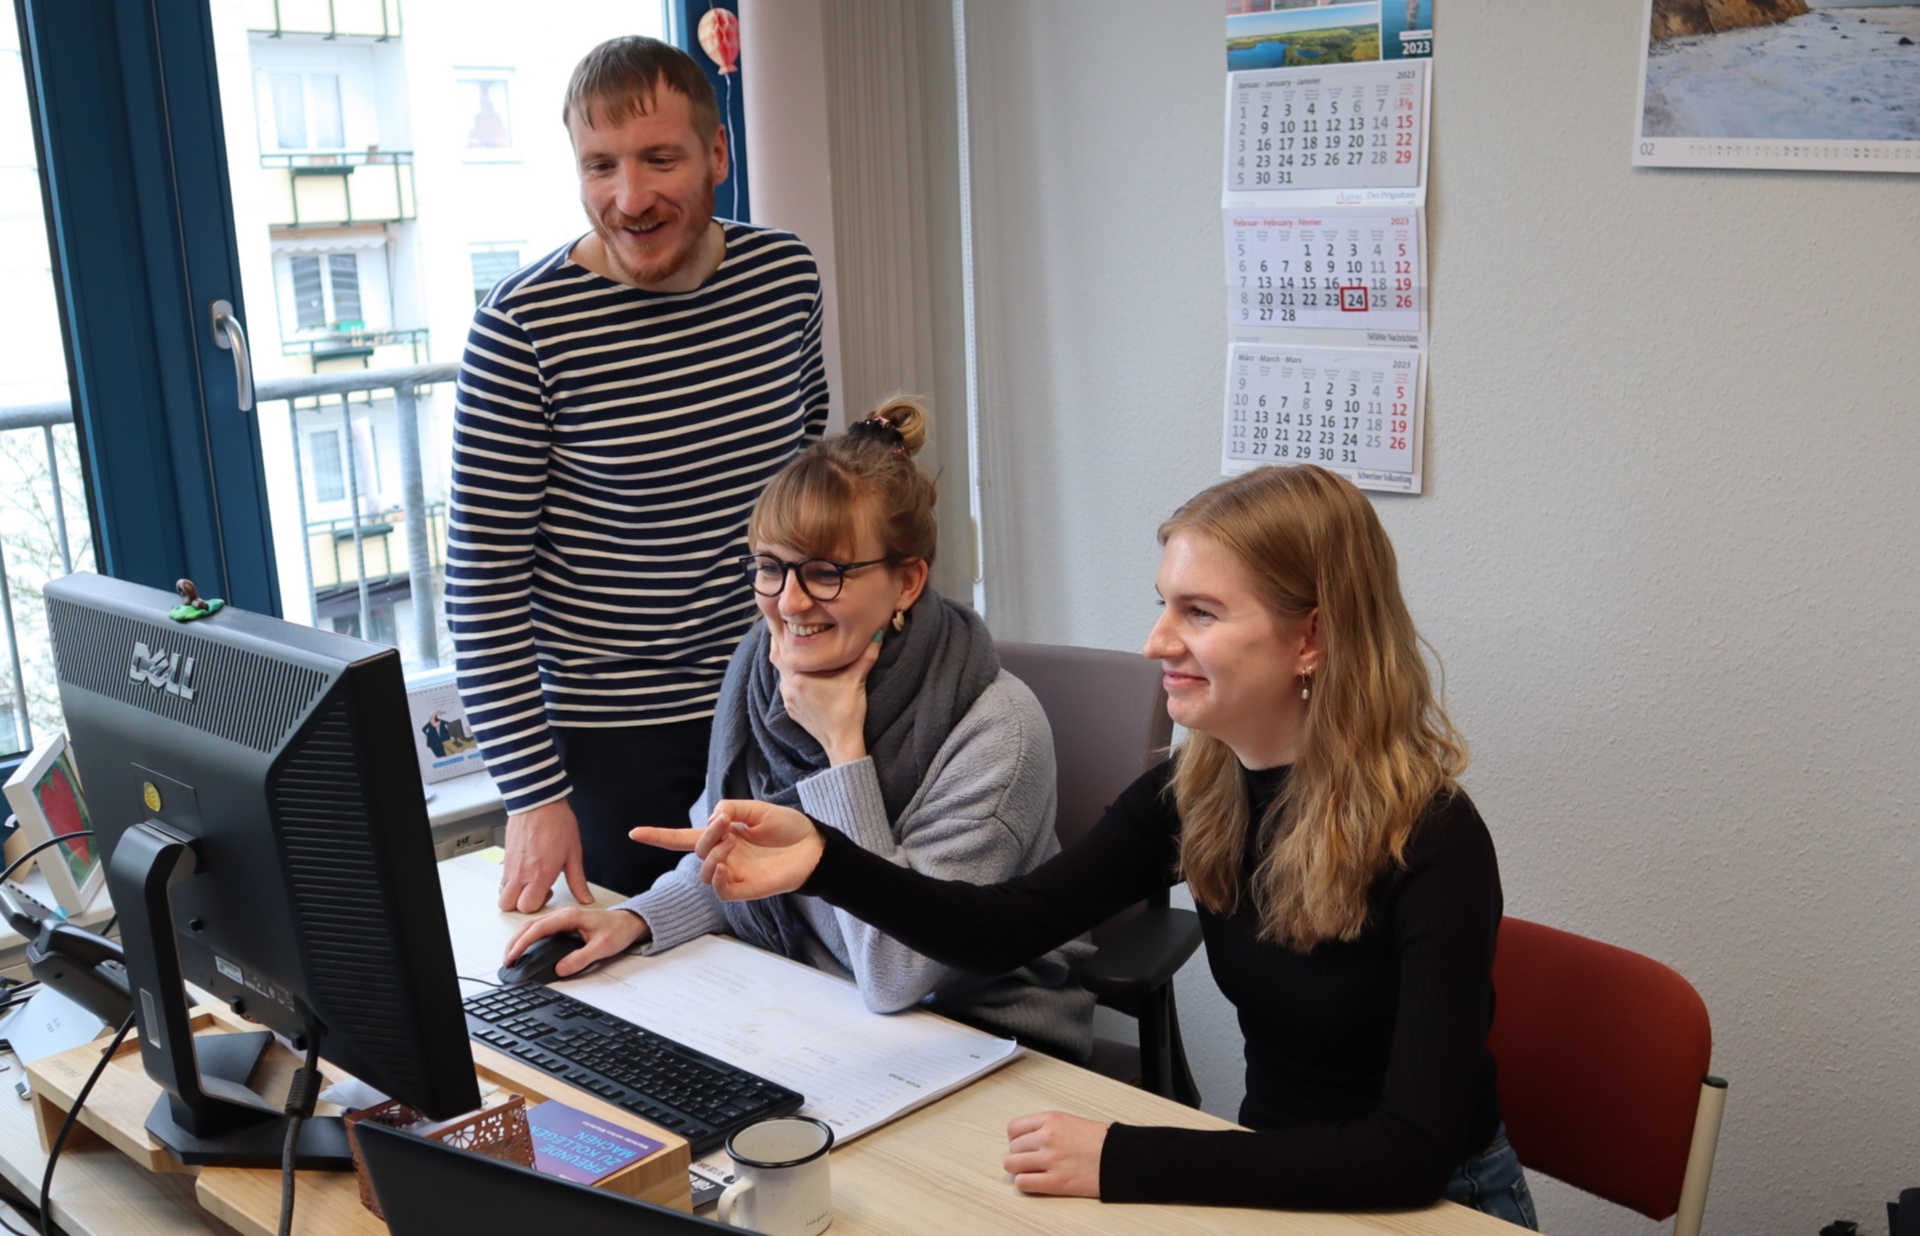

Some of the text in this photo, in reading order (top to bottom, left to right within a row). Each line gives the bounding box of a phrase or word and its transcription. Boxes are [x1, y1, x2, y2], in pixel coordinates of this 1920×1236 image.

[1402, 41, 1430, 55] 2023
[1265, 78, 1292, 88] January
[1397, 71, 1416, 79] 2023
[1240, 106, 1246, 119] 1
[1262, 105, 1269, 118] 2
[1285, 104, 1291, 116] 3
[1307, 103, 1315, 114] 4
[1331, 101, 1338, 114] 5
[1353, 100, 1361, 113] 6
[1378, 98, 1385, 111] 7
[1239, 115, 1413, 135] 2 9 10 11 12 13 14 15
[1239, 132, 1412, 152] 3 16 17 18 19 20 21 22
[1640, 142, 1655, 156] 02
[1238, 150, 1412, 168] 4 23 24 25 26 27 28 29
[1238, 171, 1292, 185] 5 30 31
[1264, 219, 1293, 227] February
[1238, 243, 1406, 257] 5 1 2 3 4 5
[1239, 260, 1410, 274] 6 6 7 8 9 10 11 12
[1240, 276, 1411, 291] 7 13 14 15 16 17 18 19
[1241, 292, 1412, 308] 8 20 21 22 23 24 25 26
[1242, 308, 1296, 321] 9 27 28
[1238, 354, 1254, 362] März
[1392, 361, 1411, 369] 2023
[1239, 378, 1404, 399] 9 1 2 3 4 5
[1234, 394, 1407, 416] 10 6 7 8 9 10 11 12
[1234, 409, 1407, 433] 11 13 14 15 16 17 18 19
[1232, 425, 1406, 450] 12 20 21 22 23 24 25 26
[1232, 441, 1356, 463] 13 27 28 29 30 31
[130, 642, 196, 701] DELL
[530, 1125, 622, 1166] ZU KOLLEGEN
[575, 1130, 637, 1158] MACHEN.
[538, 1144, 606, 1174] FREUNDE
